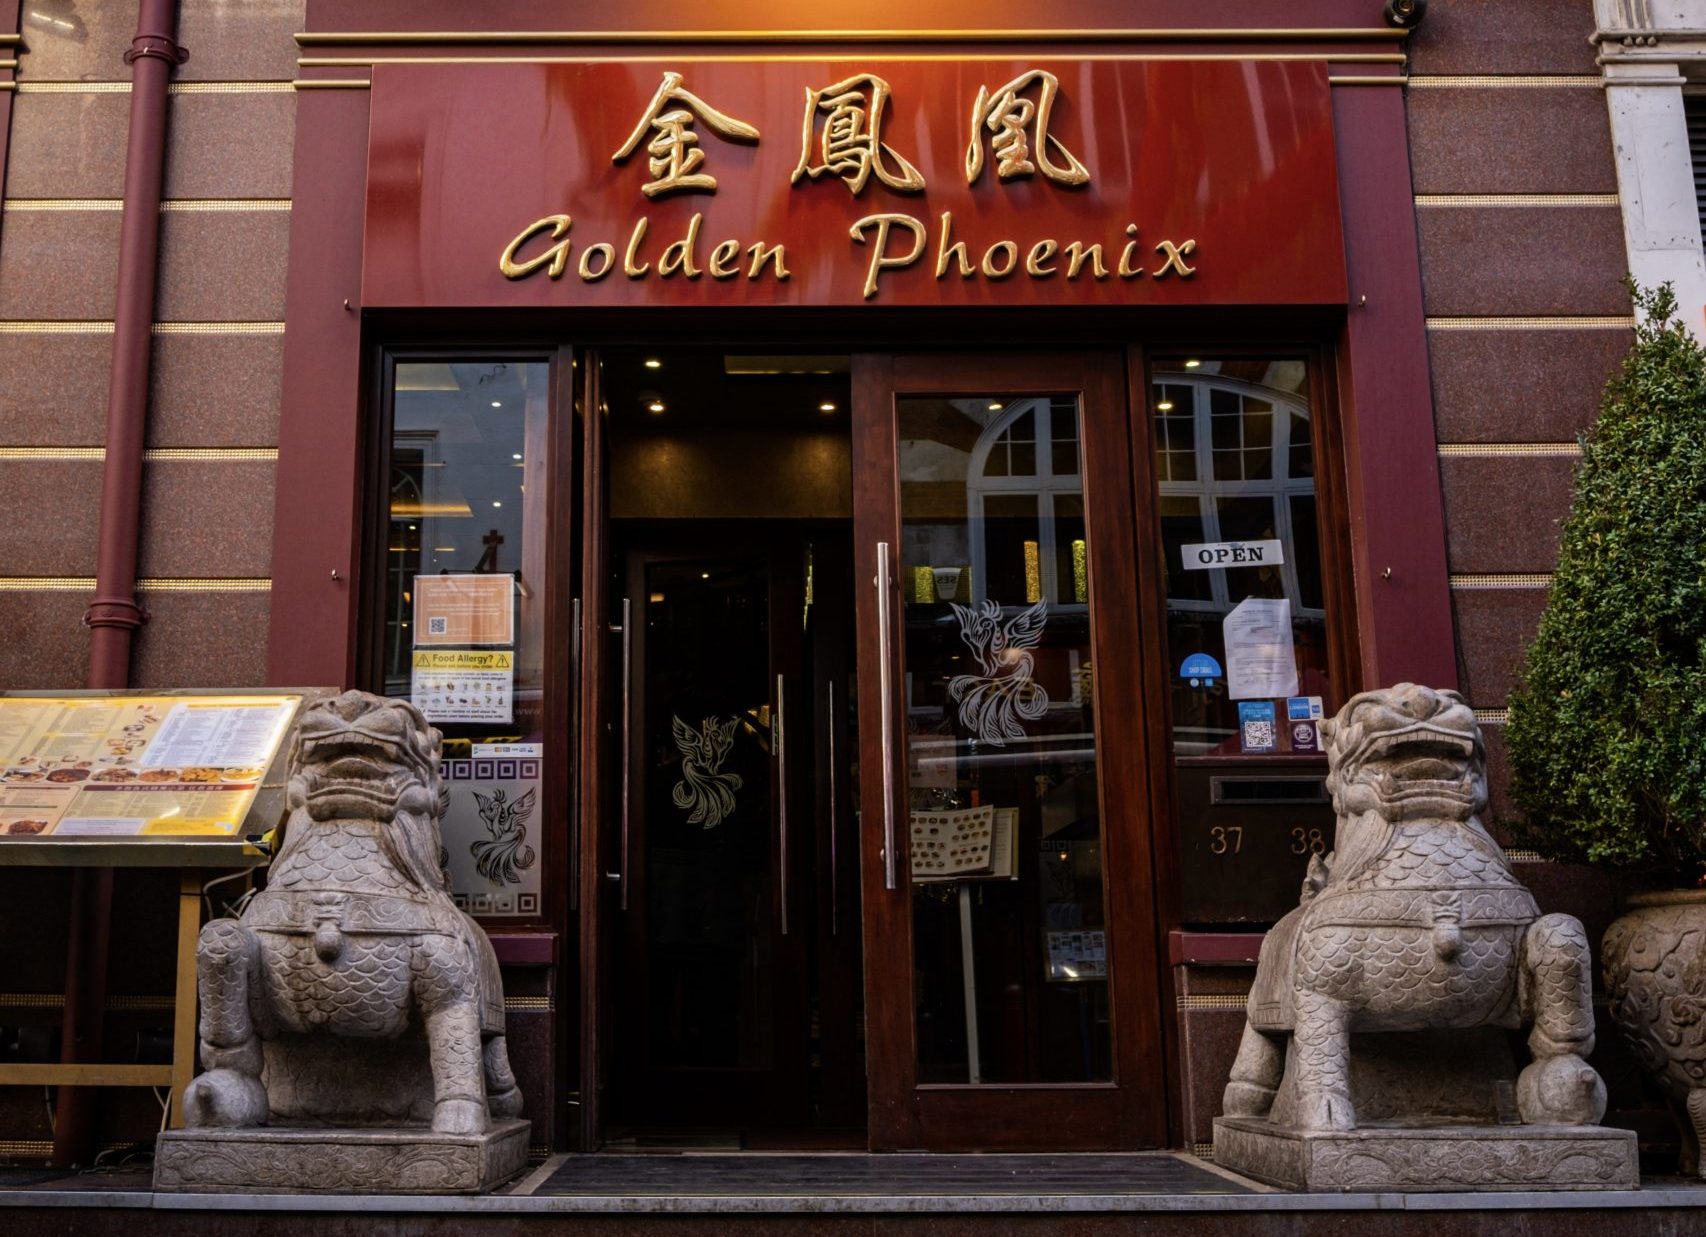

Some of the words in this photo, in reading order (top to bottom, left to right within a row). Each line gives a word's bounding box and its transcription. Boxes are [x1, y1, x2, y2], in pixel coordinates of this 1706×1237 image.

[611, 69, 1091, 195] 金鳳凰
[499, 213, 791, 281] Golden
[849, 212, 1198, 299] Phoenix
[1198, 547, 1264, 564] OPEN
[432, 654, 455, 662] Food
[457, 654, 494, 665] Allergy?
[1210, 826, 1243, 854] 37
[1291, 827, 1326, 855] 38
